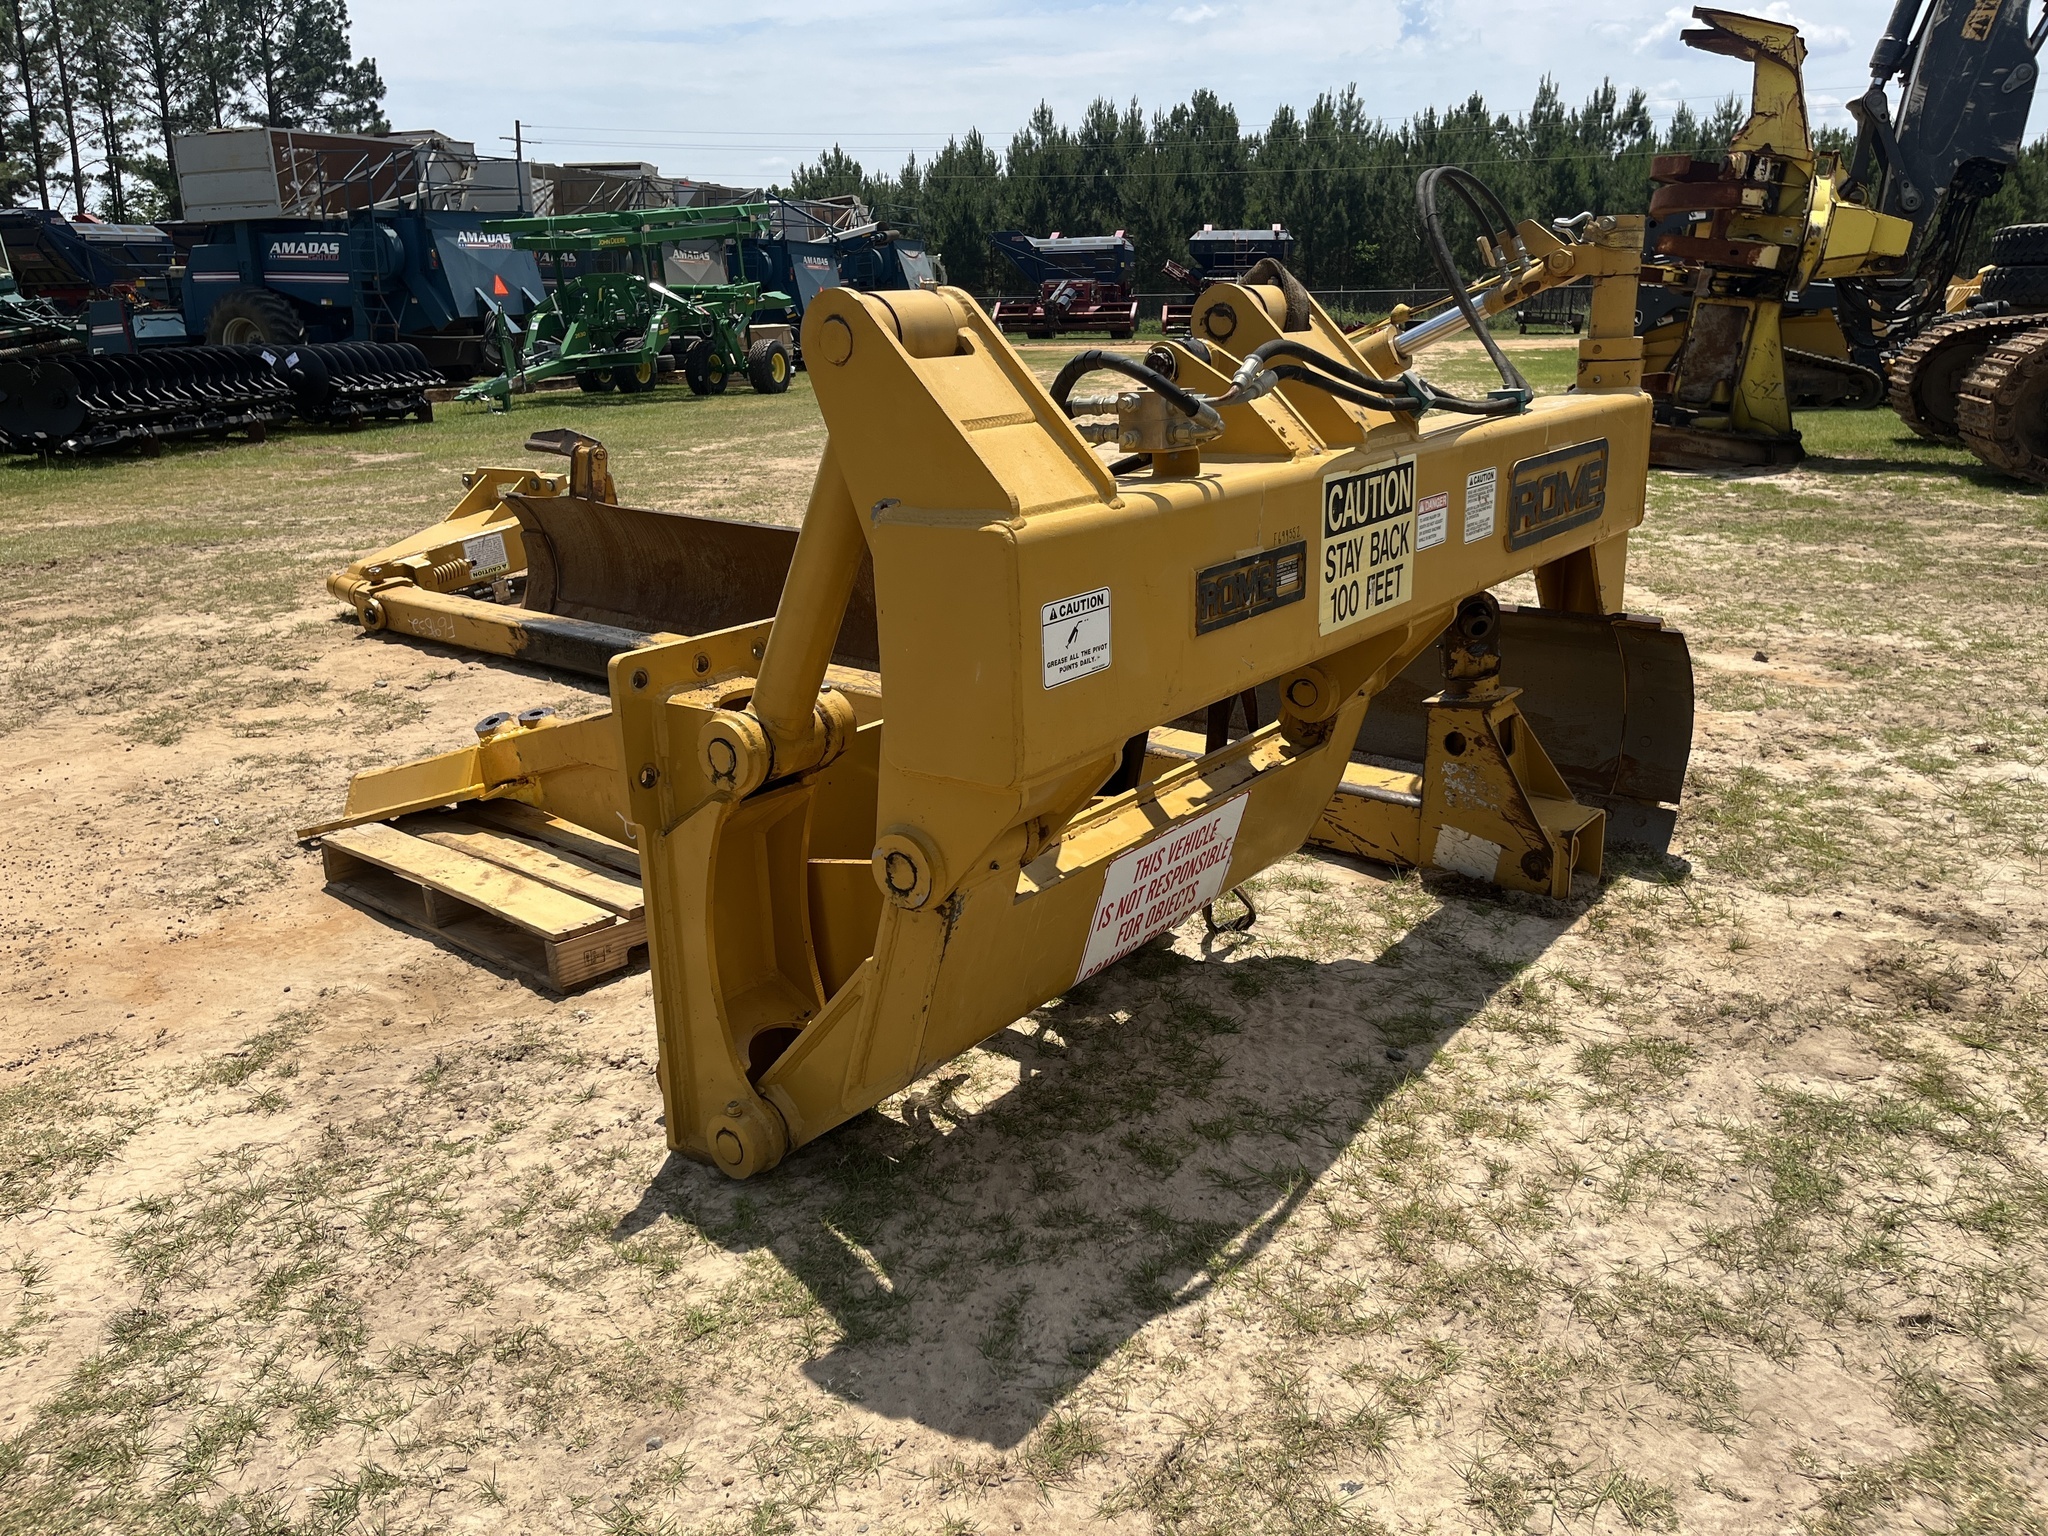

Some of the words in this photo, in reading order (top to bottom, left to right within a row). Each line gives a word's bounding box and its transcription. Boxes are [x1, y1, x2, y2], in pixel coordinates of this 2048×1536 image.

[270, 242, 340, 255] AMADAS
[611, 237, 626, 245] DEERE
[803, 256, 829, 266] AMADAS
[1473, 471, 1495, 485] CAUTION
[1328, 467, 1412, 532] CAUTION
[1424, 495, 1447, 511] DANGER
[1514, 458, 1603, 533] ROME
[1324, 535, 1364, 584] STAY
[1369, 521, 1410, 568] BACK
[472, 564, 502, 578] CAUTION
[1200, 563, 1274, 620] ROME
[1330, 580, 1359, 624] 100
[1365, 563, 1404, 611] FEET
[1059, 593, 1104, 617] CAUTION
[1046, 656, 1068, 669] GREASE
[1069, 652, 1079, 661] ALL
[1081, 648, 1091, 657] THE
[1092, 643, 1108, 653] PIVOT
[1059, 661, 1078, 673] POINTS
[1133, 847, 1166, 884] THIS
[1167, 818, 1221, 866] VEHICLE
[1096, 902, 1115, 932] IS
[1115, 884, 1146, 922] NOT
[1145, 837, 1232, 904] RESPONSIBLE
[1115, 912, 1144, 948] FOR
[1144, 880, 1200, 930] OBJECTS
